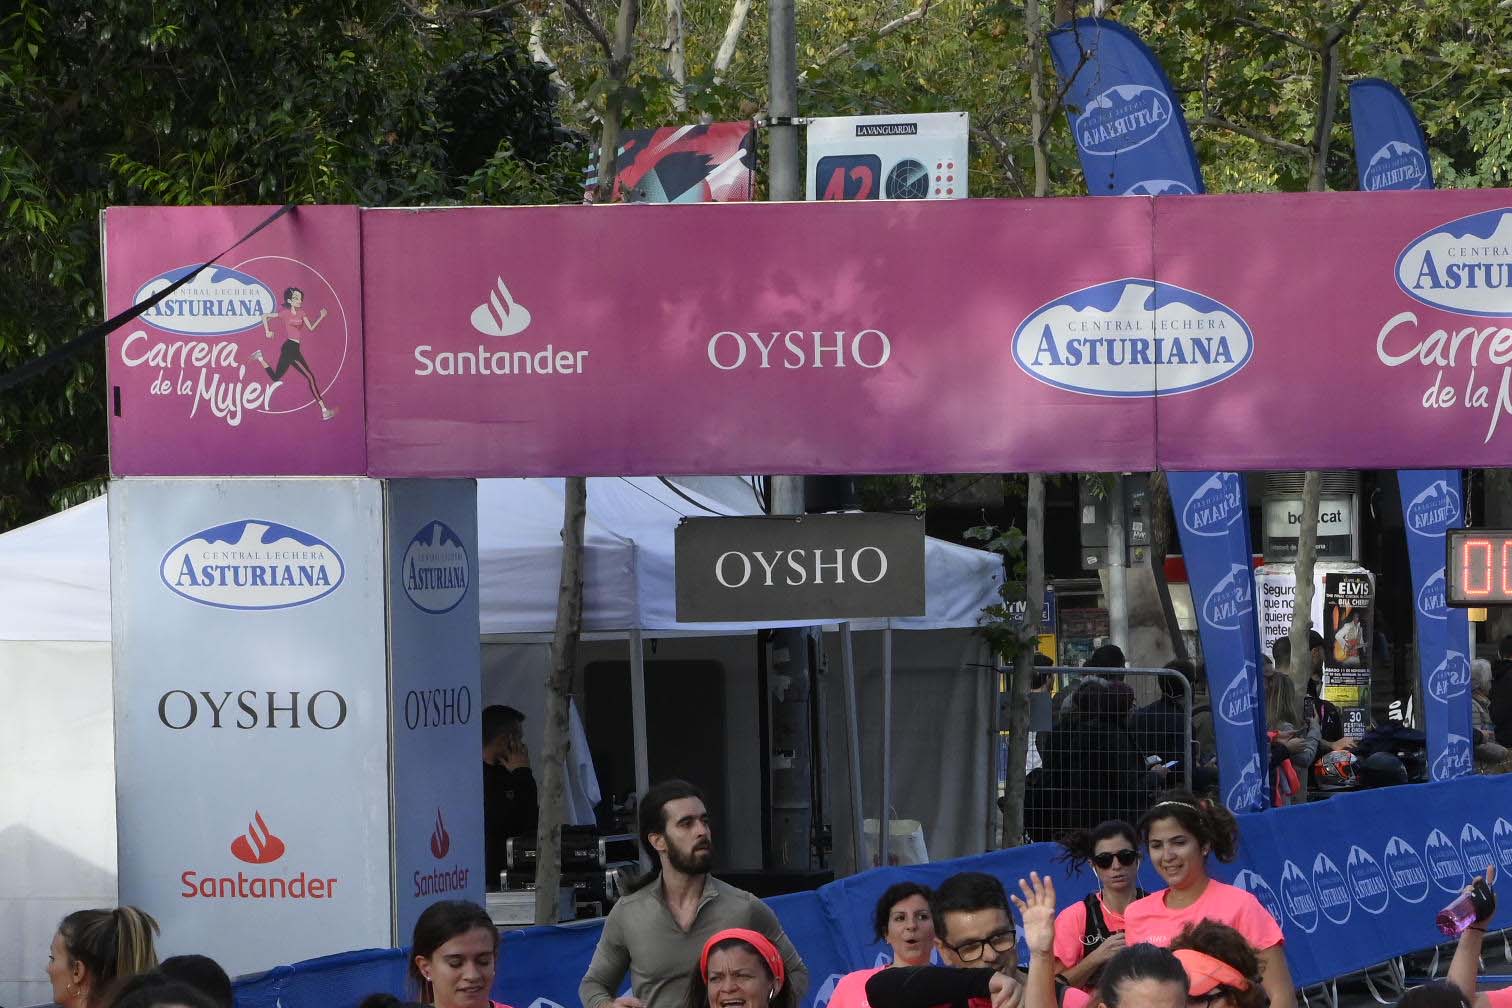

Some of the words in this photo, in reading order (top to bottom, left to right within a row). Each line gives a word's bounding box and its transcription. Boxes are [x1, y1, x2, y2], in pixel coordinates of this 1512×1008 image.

[144, 288, 264, 318] ASTURIANA
[170, 287, 211, 297] ENTRAL
[214, 287, 260, 296] LECHERA
[1068, 319, 1144, 333] CENTRAL
[1152, 318, 1227, 332] LECHERA
[121, 331, 236, 369] Carrera
[415, 344, 589, 377] Santander
[707, 329, 891, 370] OYSHO
[1031, 325, 1235, 366] ASTURIANA
[151, 371, 172, 396] de
[177, 369, 193, 396] la
[190, 365, 283, 426] Mujer
[1422, 370, 1457, 409] de
[1464, 366, 1489, 408] la
[1288, 509, 1342, 525] b.cat
[176, 552, 331, 588] ASTURIANA
[203, 551, 261, 561] CENTRAL
[267, 551, 325, 561] LECHERA
[715, 546, 888, 588] OYSHO
[408, 557, 466, 592] ASTURIANA
[1338, 582, 1369, 595] ELVIS
[1263, 601, 1280, 611] que
[158, 689, 348, 731] OYSHO
[405, 685, 471, 731] OYSHO
[1349, 712, 1362, 722] 30
[181, 871, 338, 899] Santander
[413, 865, 470, 899] Santander
